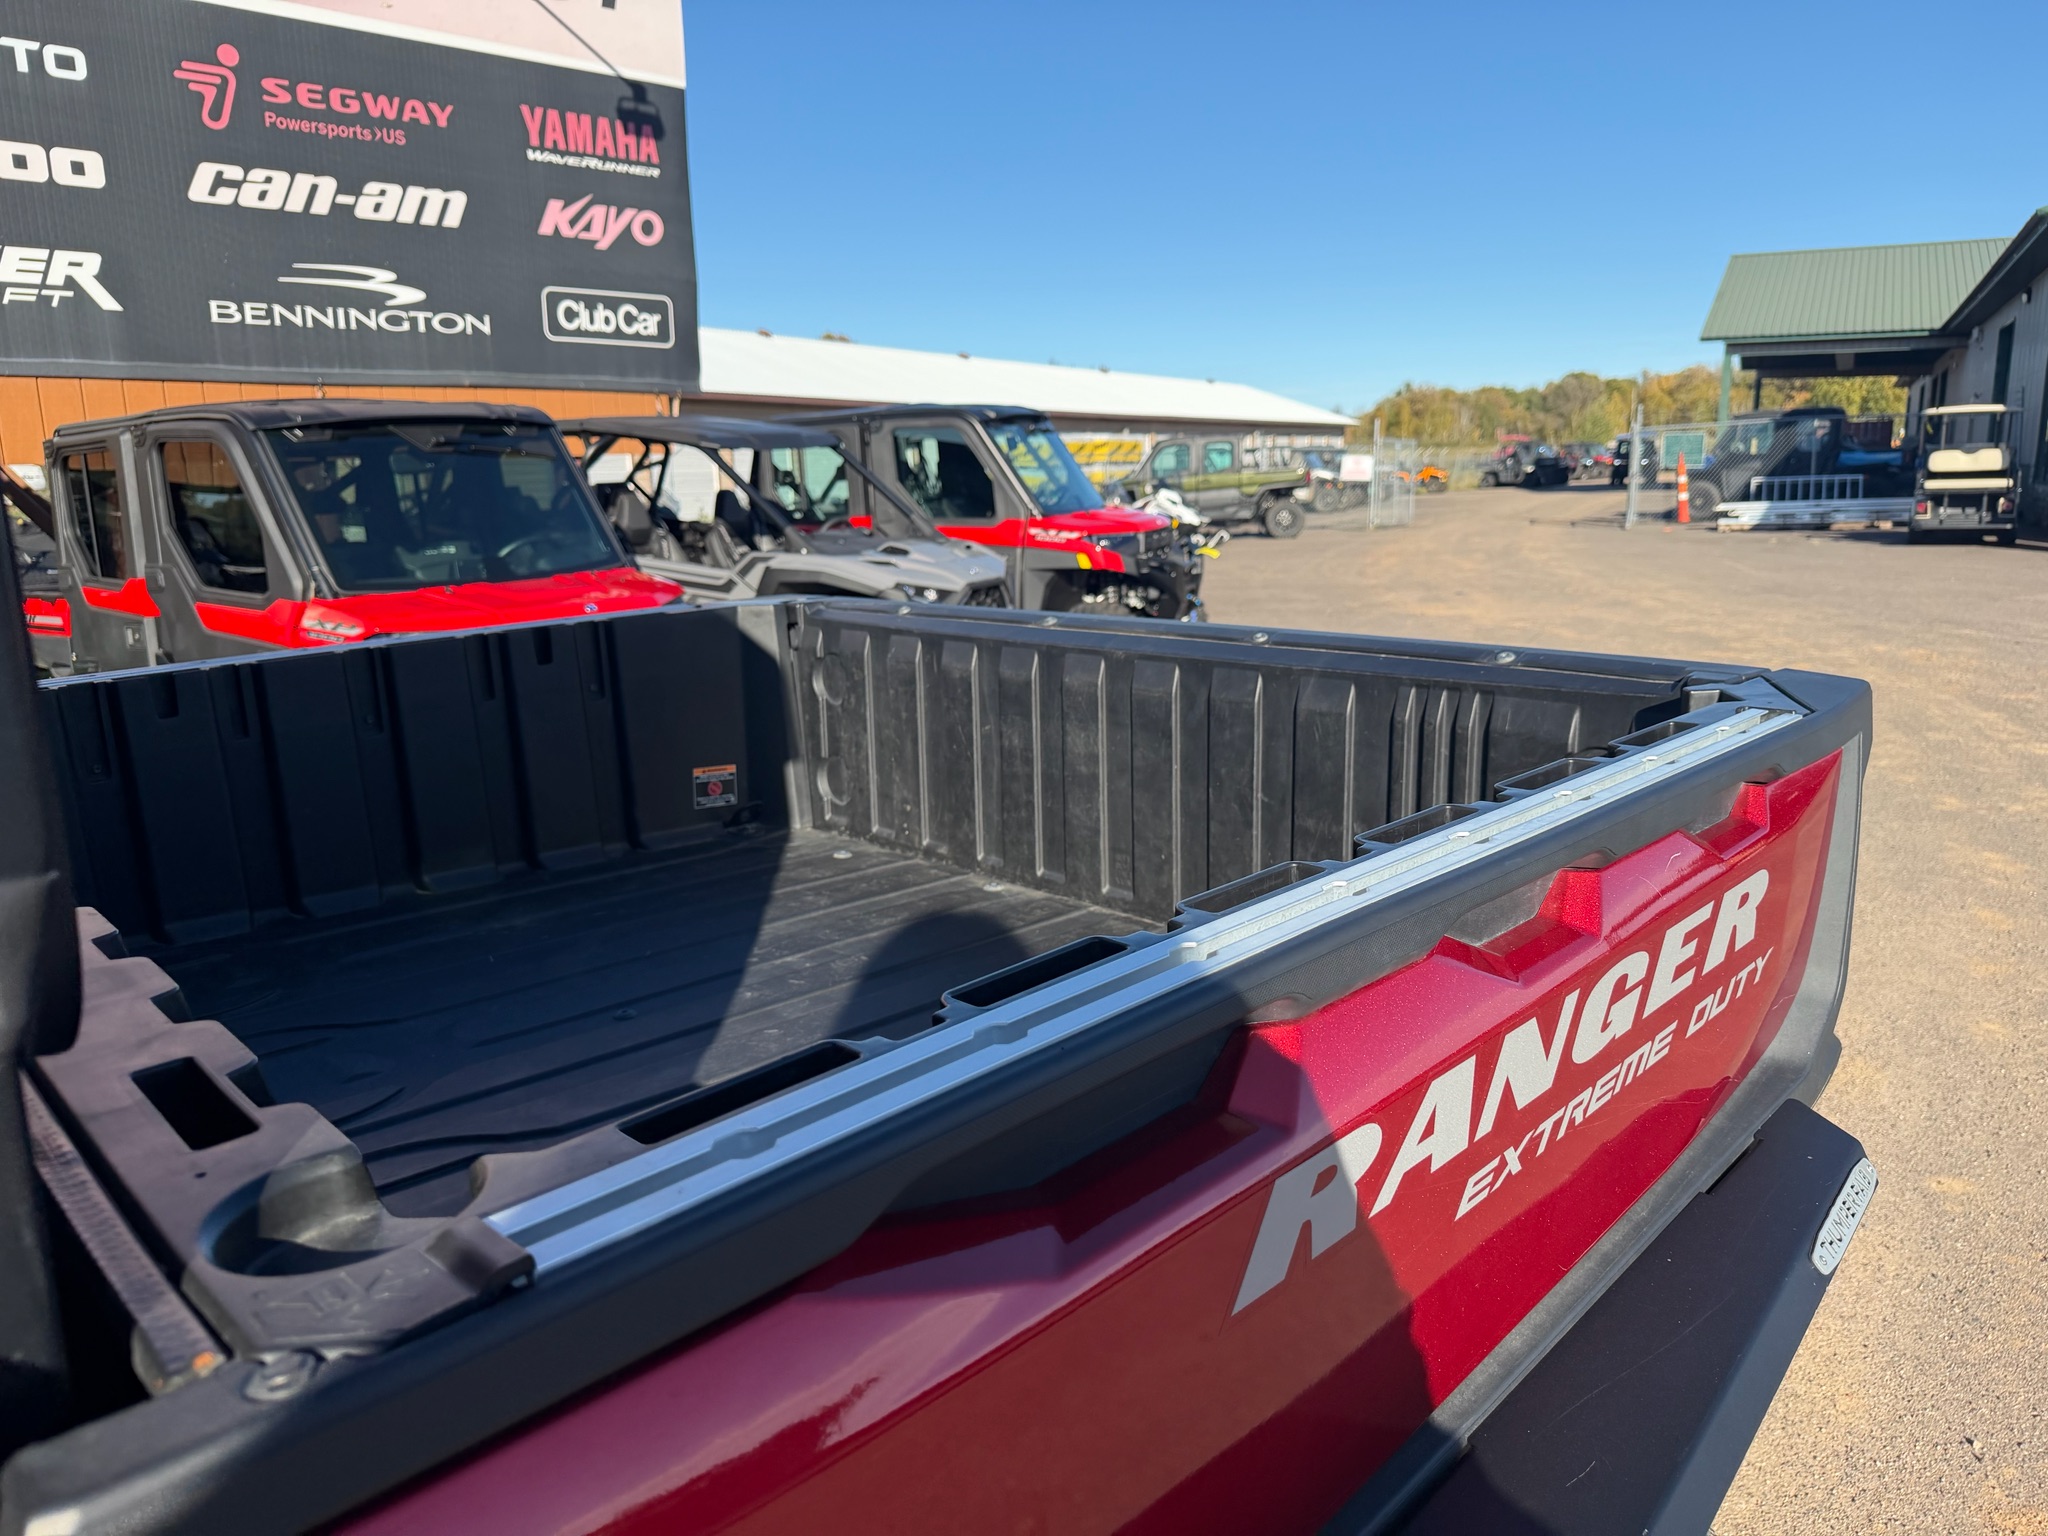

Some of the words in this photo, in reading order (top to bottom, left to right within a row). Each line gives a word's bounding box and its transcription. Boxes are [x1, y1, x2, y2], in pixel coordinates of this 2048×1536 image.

[0, 36, 88, 81] TO
[260, 77, 454, 128] SEGWAY
[519, 103, 660, 165] YAMAHA
[526, 148, 661, 179] WAVERUNNER
[537, 193, 665, 251] KAYO
[0, 245, 124, 311] ER
[208, 299, 492, 336] BENNINGTON
[1231, 869, 1770, 1317] RANGER
[1454, 1020, 1678, 1222] EXTREME
[1685, 947, 1774, 1039] DUTY
